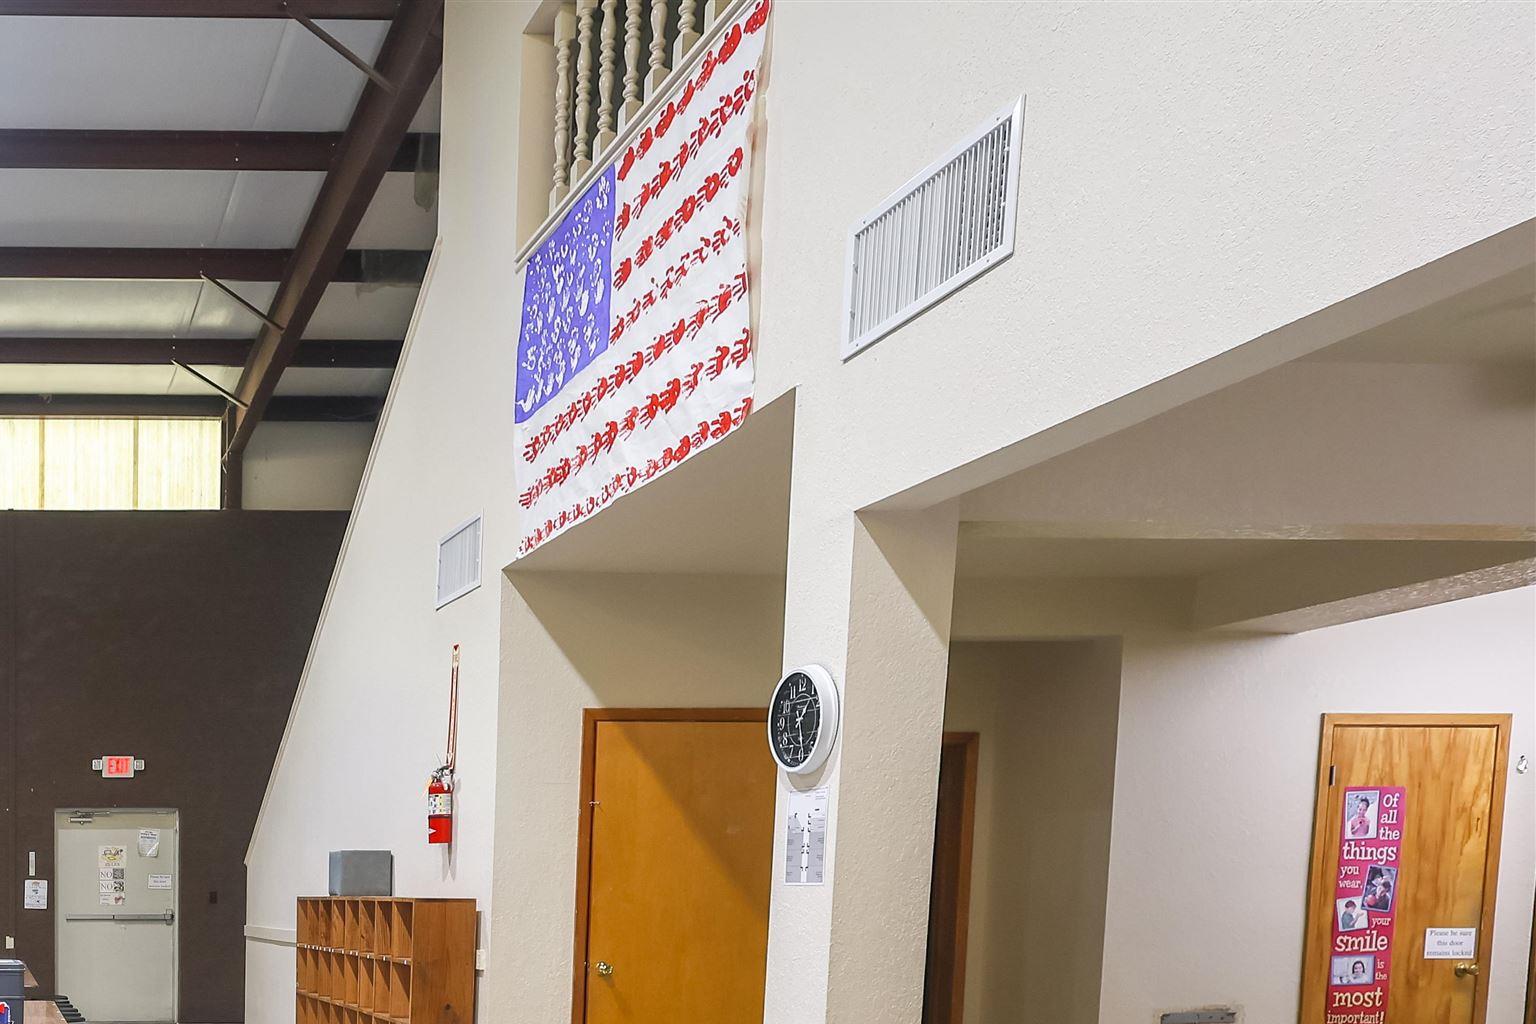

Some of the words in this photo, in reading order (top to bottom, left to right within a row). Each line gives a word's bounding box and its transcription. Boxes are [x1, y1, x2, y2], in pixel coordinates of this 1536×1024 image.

[798, 677, 807, 692] 12
[789, 684, 796, 700] 11
[782, 701, 791, 715] 10
[779, 717, 785, 731] 9
[782, 732, 788, 746] 8
[789, 745, 794, 758] 7
[107, 758, 131, 774] EXIT
[1383, 793, 1400, 808] Of
[1380, 810, 1398, 824] all
[1379, 827, 1401, 841] the
[1342, 841, 1397, 865] things
[1340, 865, 1360, 879] you
[1371, 917, 1391, 929] your
[1335, 930, 1388, 952] smile
[1377, 959, 1385, 969] is
[1375, 971, 1388, 980] the
[1332, 986, 1383, 1008] most
